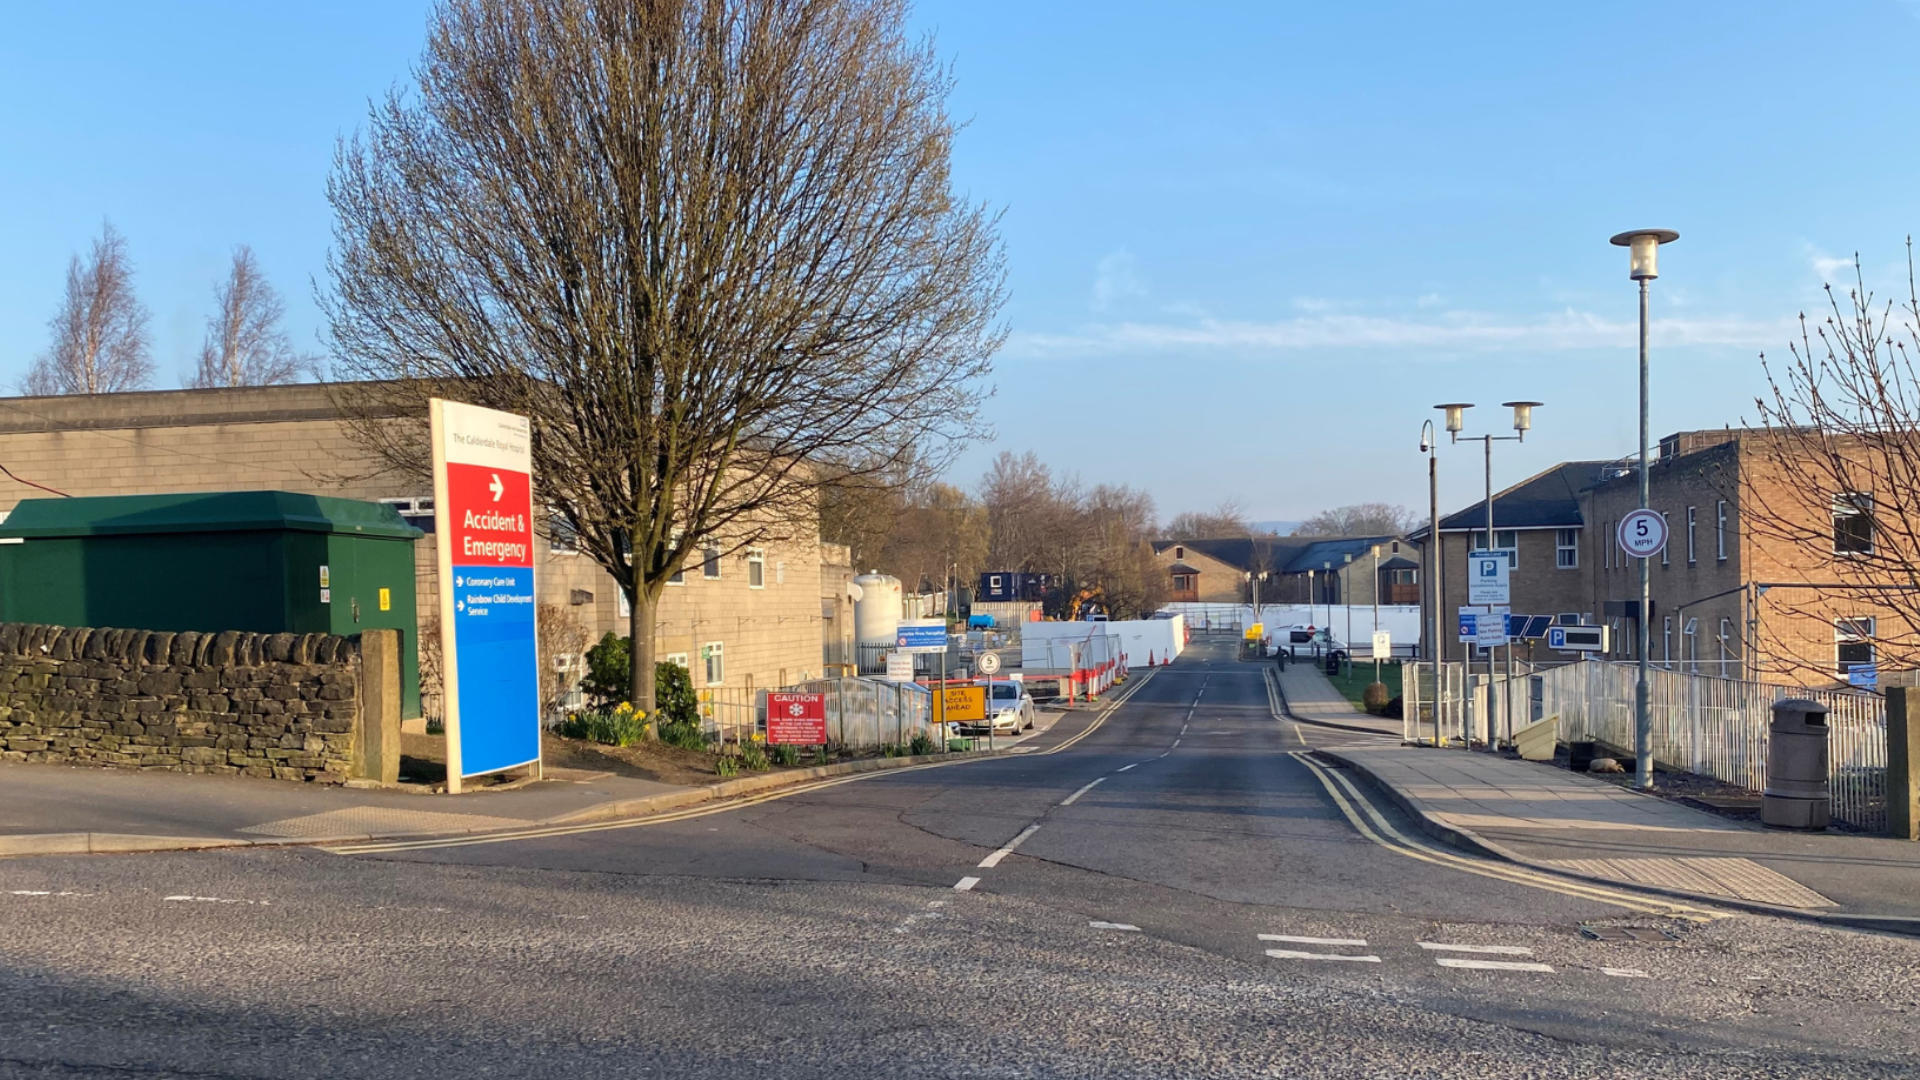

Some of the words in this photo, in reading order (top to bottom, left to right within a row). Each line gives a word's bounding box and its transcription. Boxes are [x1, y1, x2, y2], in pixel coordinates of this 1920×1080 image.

[454, 434, 465, 444] The
[466, 435, 495, 448] Calderdale
[496, 440, 508, 451] Royal
[509, 444, 525, 454] Hospital
[464, 509, 516, 532] Accident
[518, 514, 524, 532] &
[1636, 520, 1648, 536] 5
[464, 536, 526, 562] Emergency
[1483, 562, 1494, 575] P
[466, 577, 493, 588] Coronary
[493, 577, 505, 586] Care
[506, 578, 515, 586] Unit
[467, 595, 492, 604] Rainbow
[493, 594, 506, 603] Child
[507, 594, 532, 605] Development
[468, 607, 488, 616] Service
[1553, 631, 1562, 644] P
